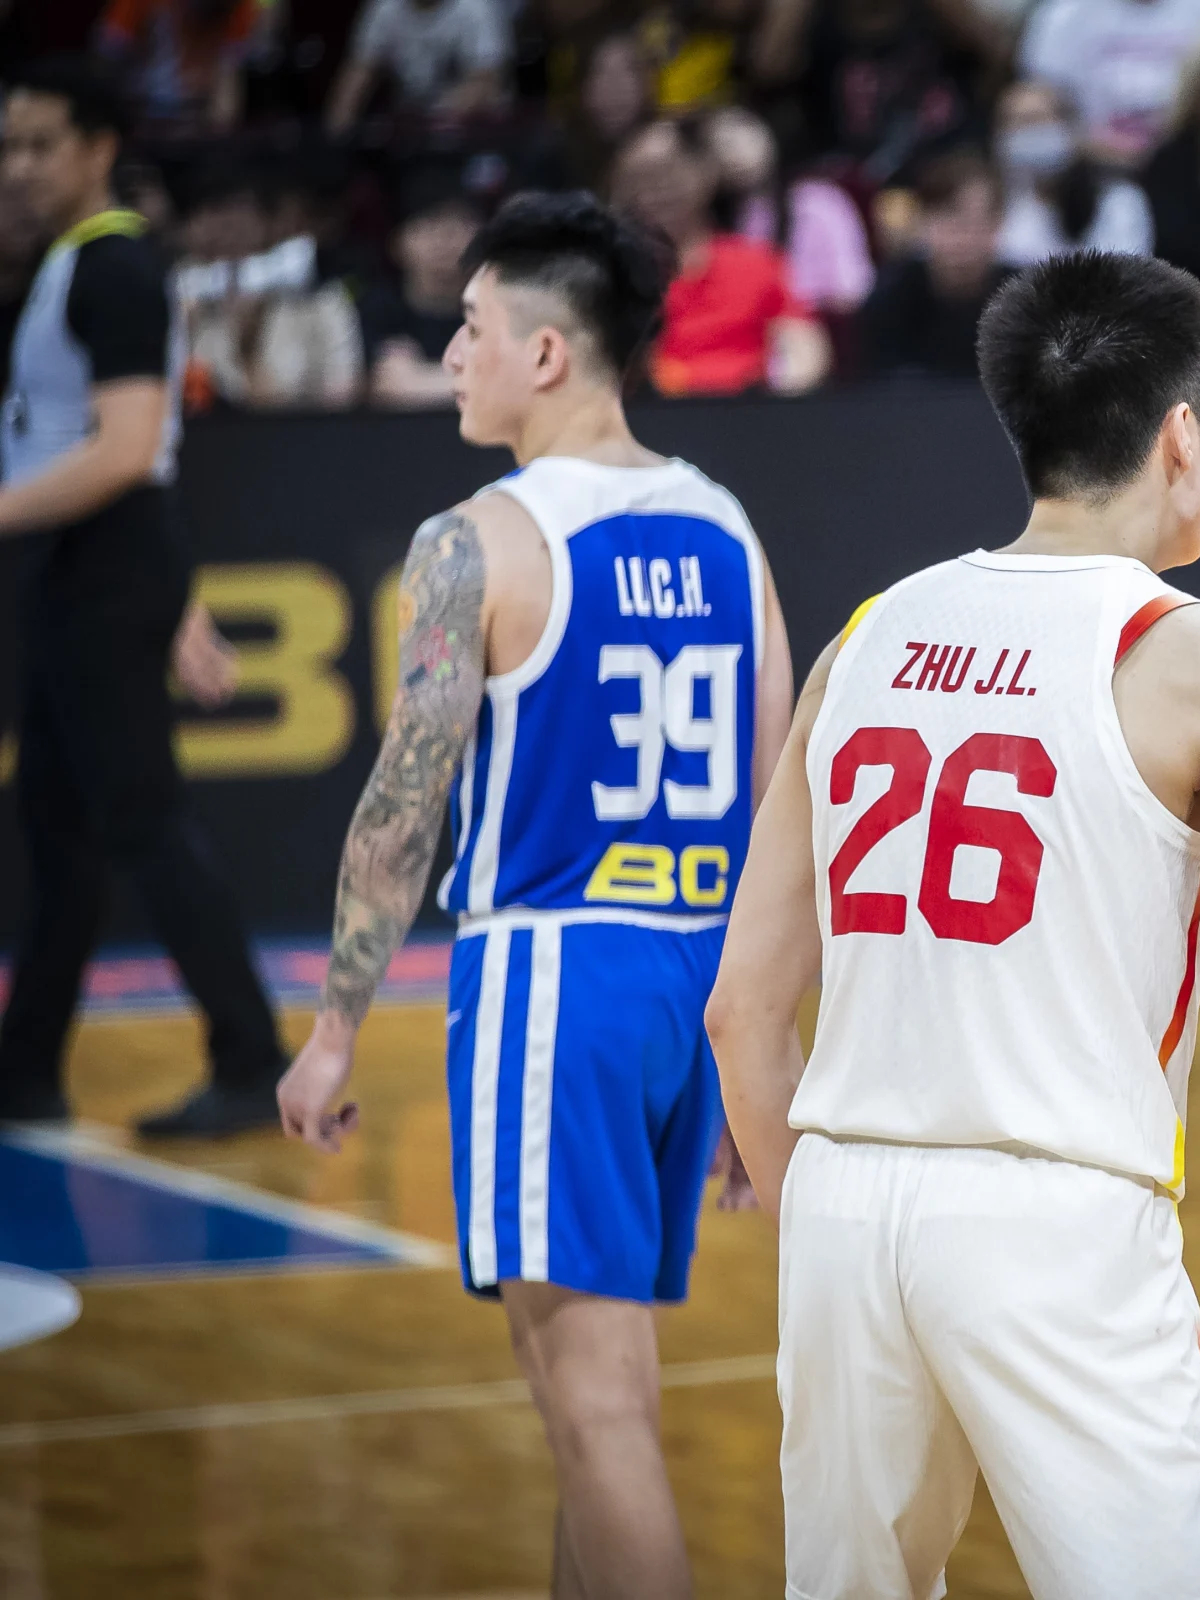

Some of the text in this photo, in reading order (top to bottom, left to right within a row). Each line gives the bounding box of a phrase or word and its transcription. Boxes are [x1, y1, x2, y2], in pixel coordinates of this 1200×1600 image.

[891, 642, 1037, 696] ZHU J.L.
[591, 644, 743, 821] 39
[583, 842, 730, 908] BC
[829, 727, 1057, 946] 26
